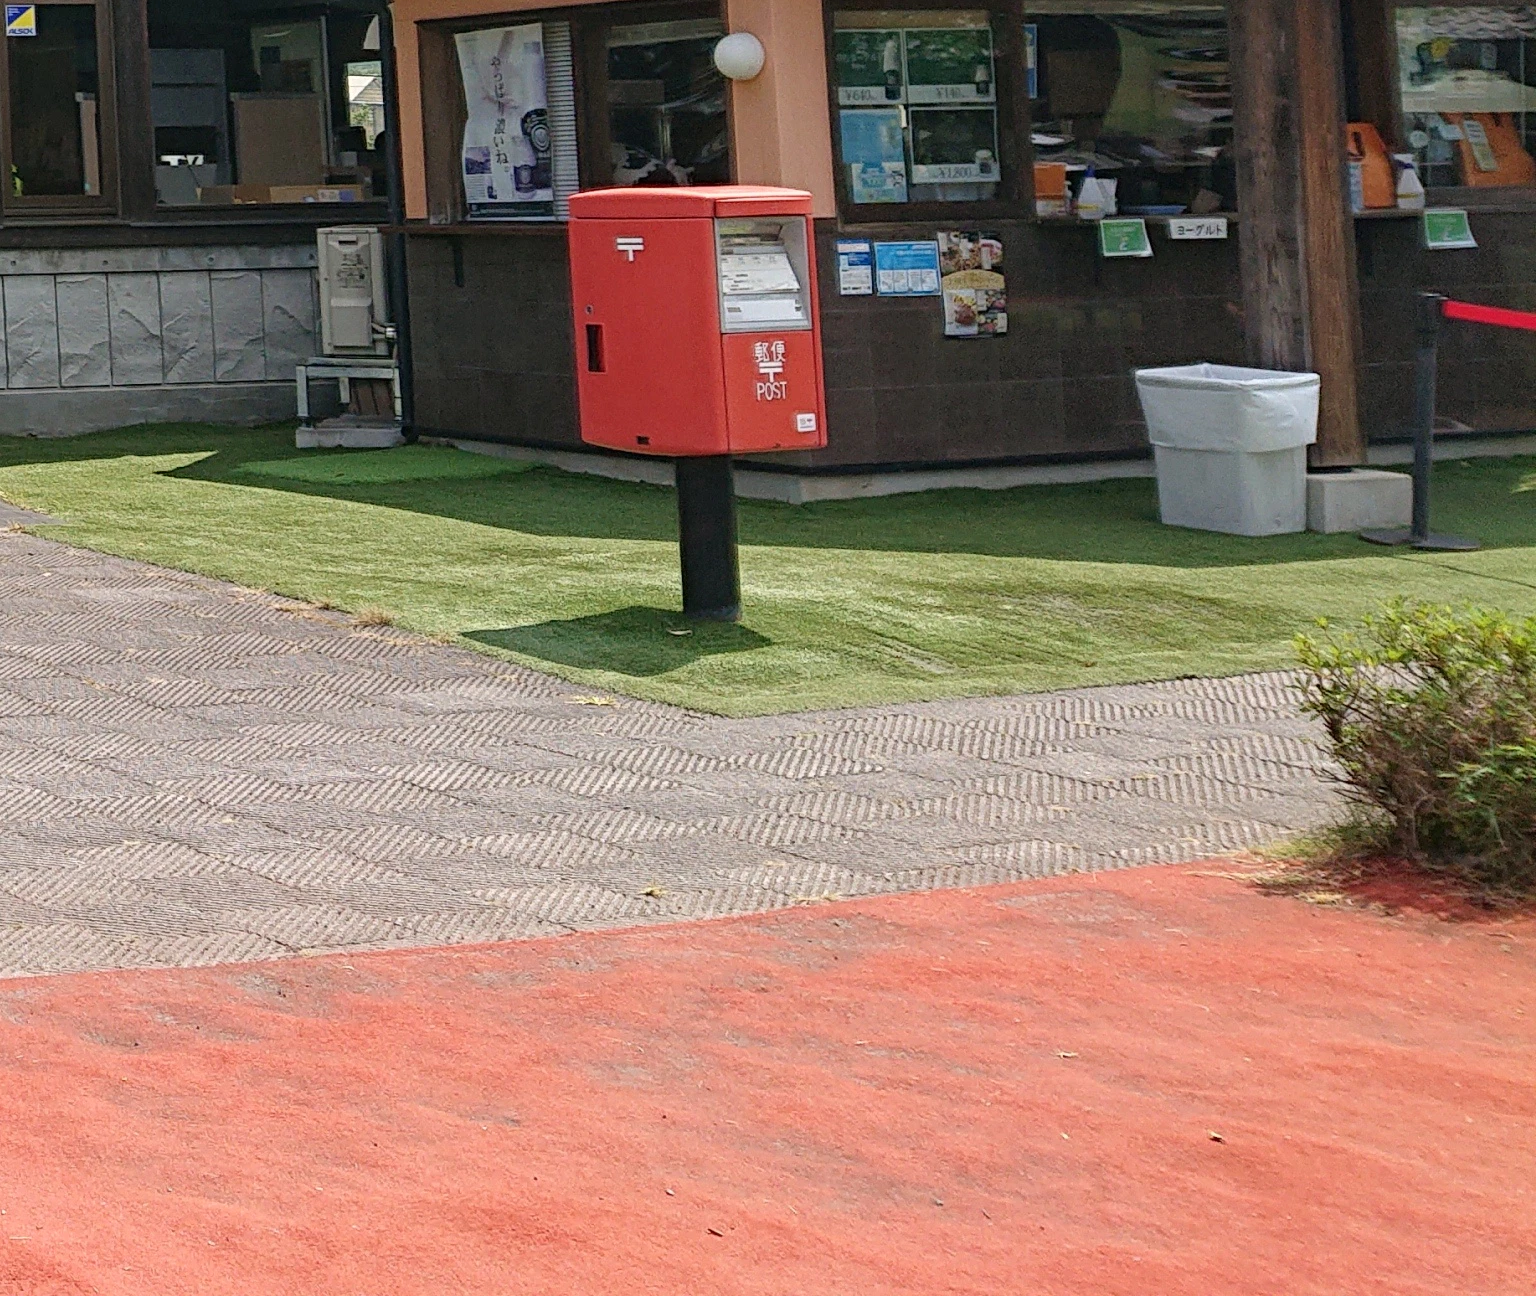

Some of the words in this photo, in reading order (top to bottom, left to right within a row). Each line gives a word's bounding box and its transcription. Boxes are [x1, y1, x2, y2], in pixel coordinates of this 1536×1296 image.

[1176, 224, 1223, 237] ヨーグルト
[754, 340, 786, 363] 郵便
[756, 381, 788, 401] POST
